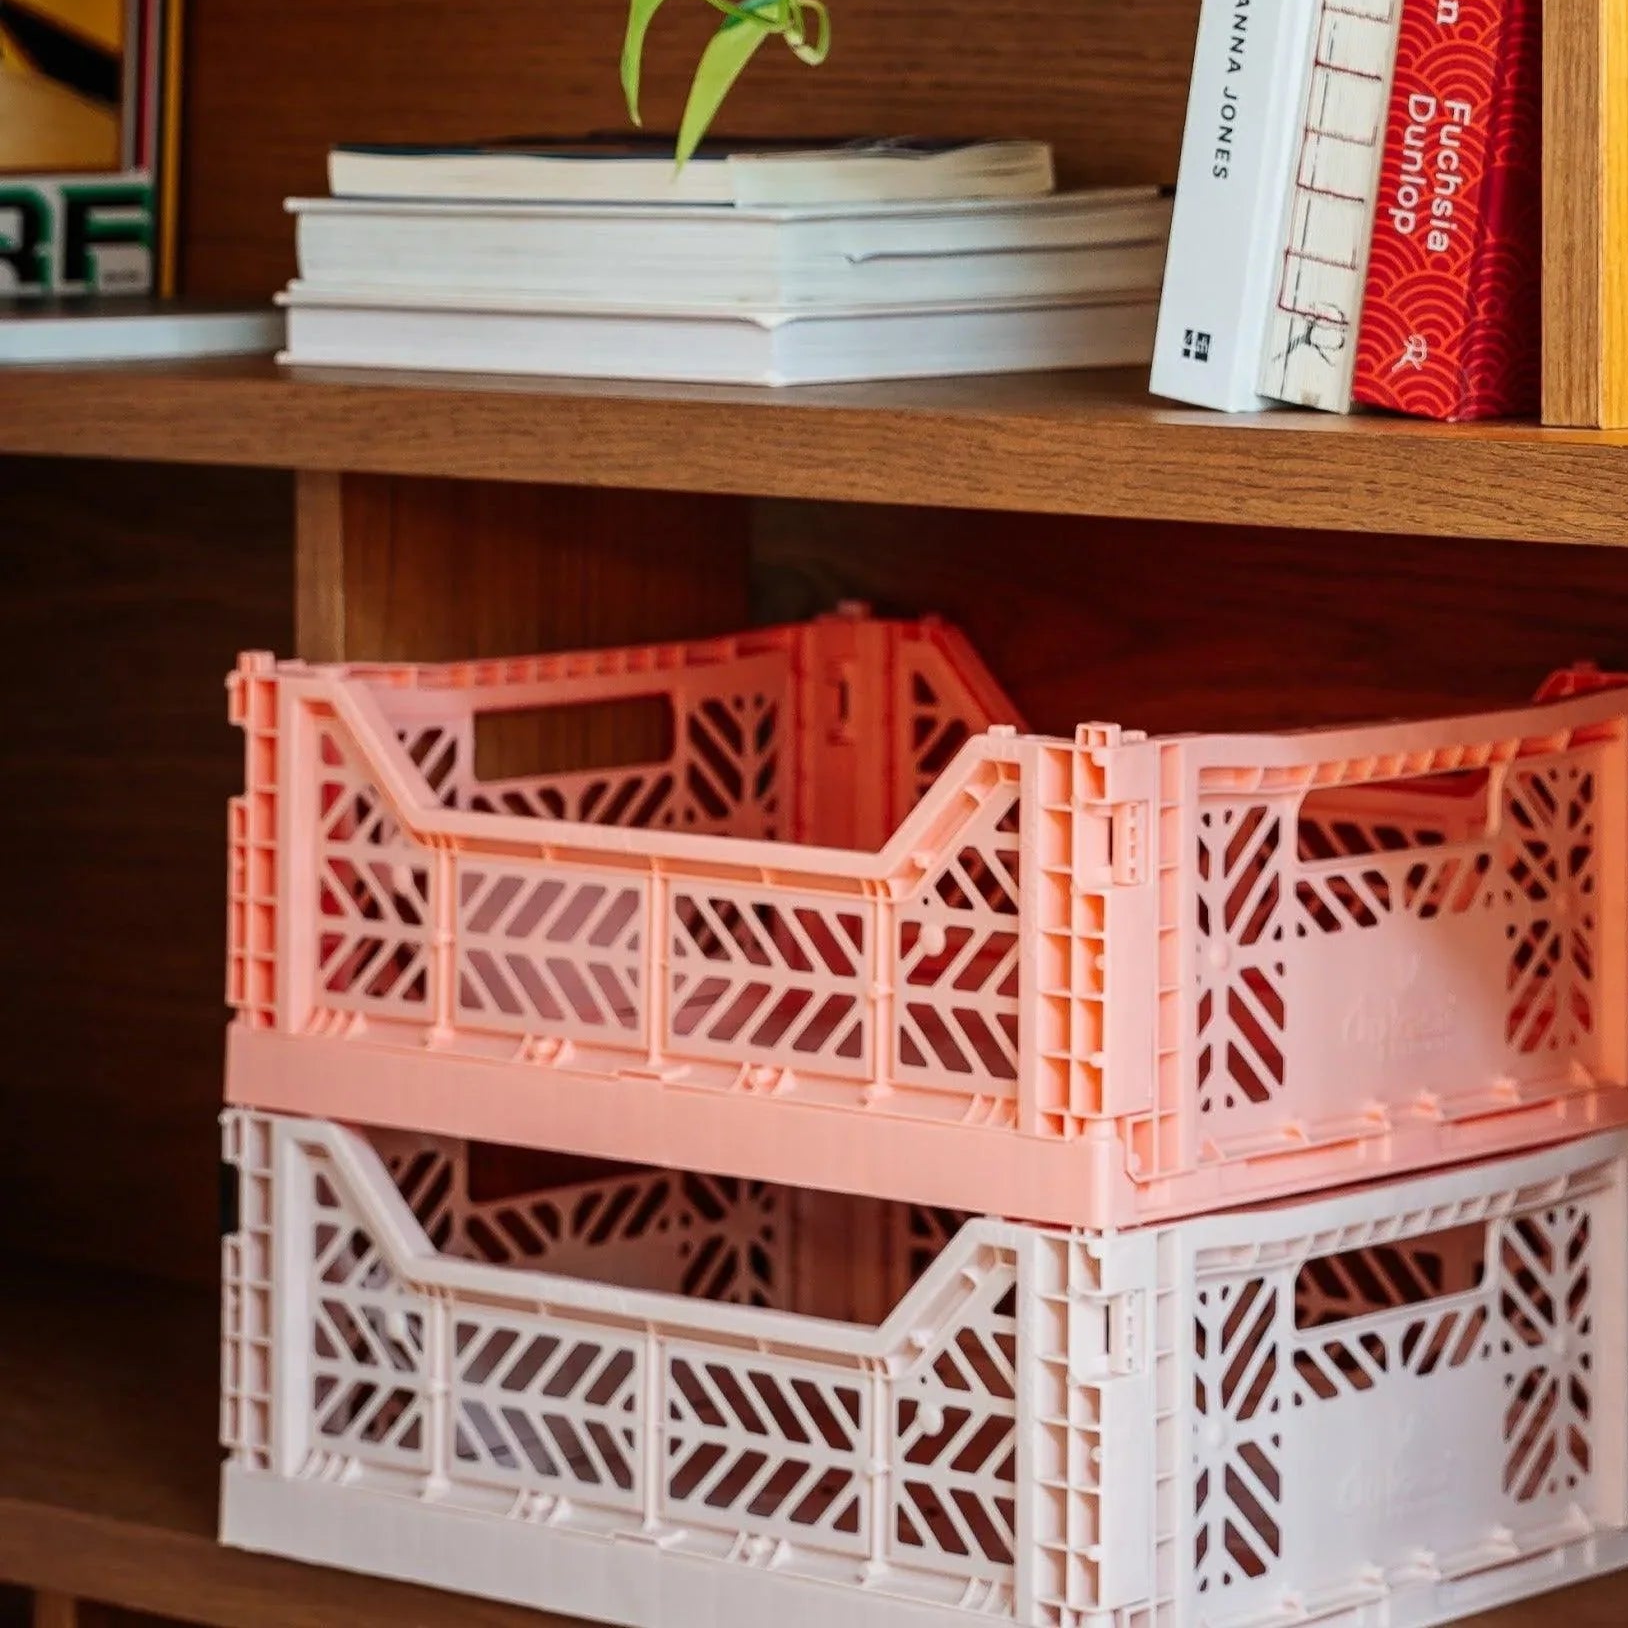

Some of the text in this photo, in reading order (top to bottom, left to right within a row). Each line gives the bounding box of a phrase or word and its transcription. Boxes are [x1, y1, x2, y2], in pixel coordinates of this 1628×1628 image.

[1212, 86, 1240, 180] JONES
[1388, 93, 1437, 235] Dunlop
[1426, 99, 1472, 252] Fuchsia
